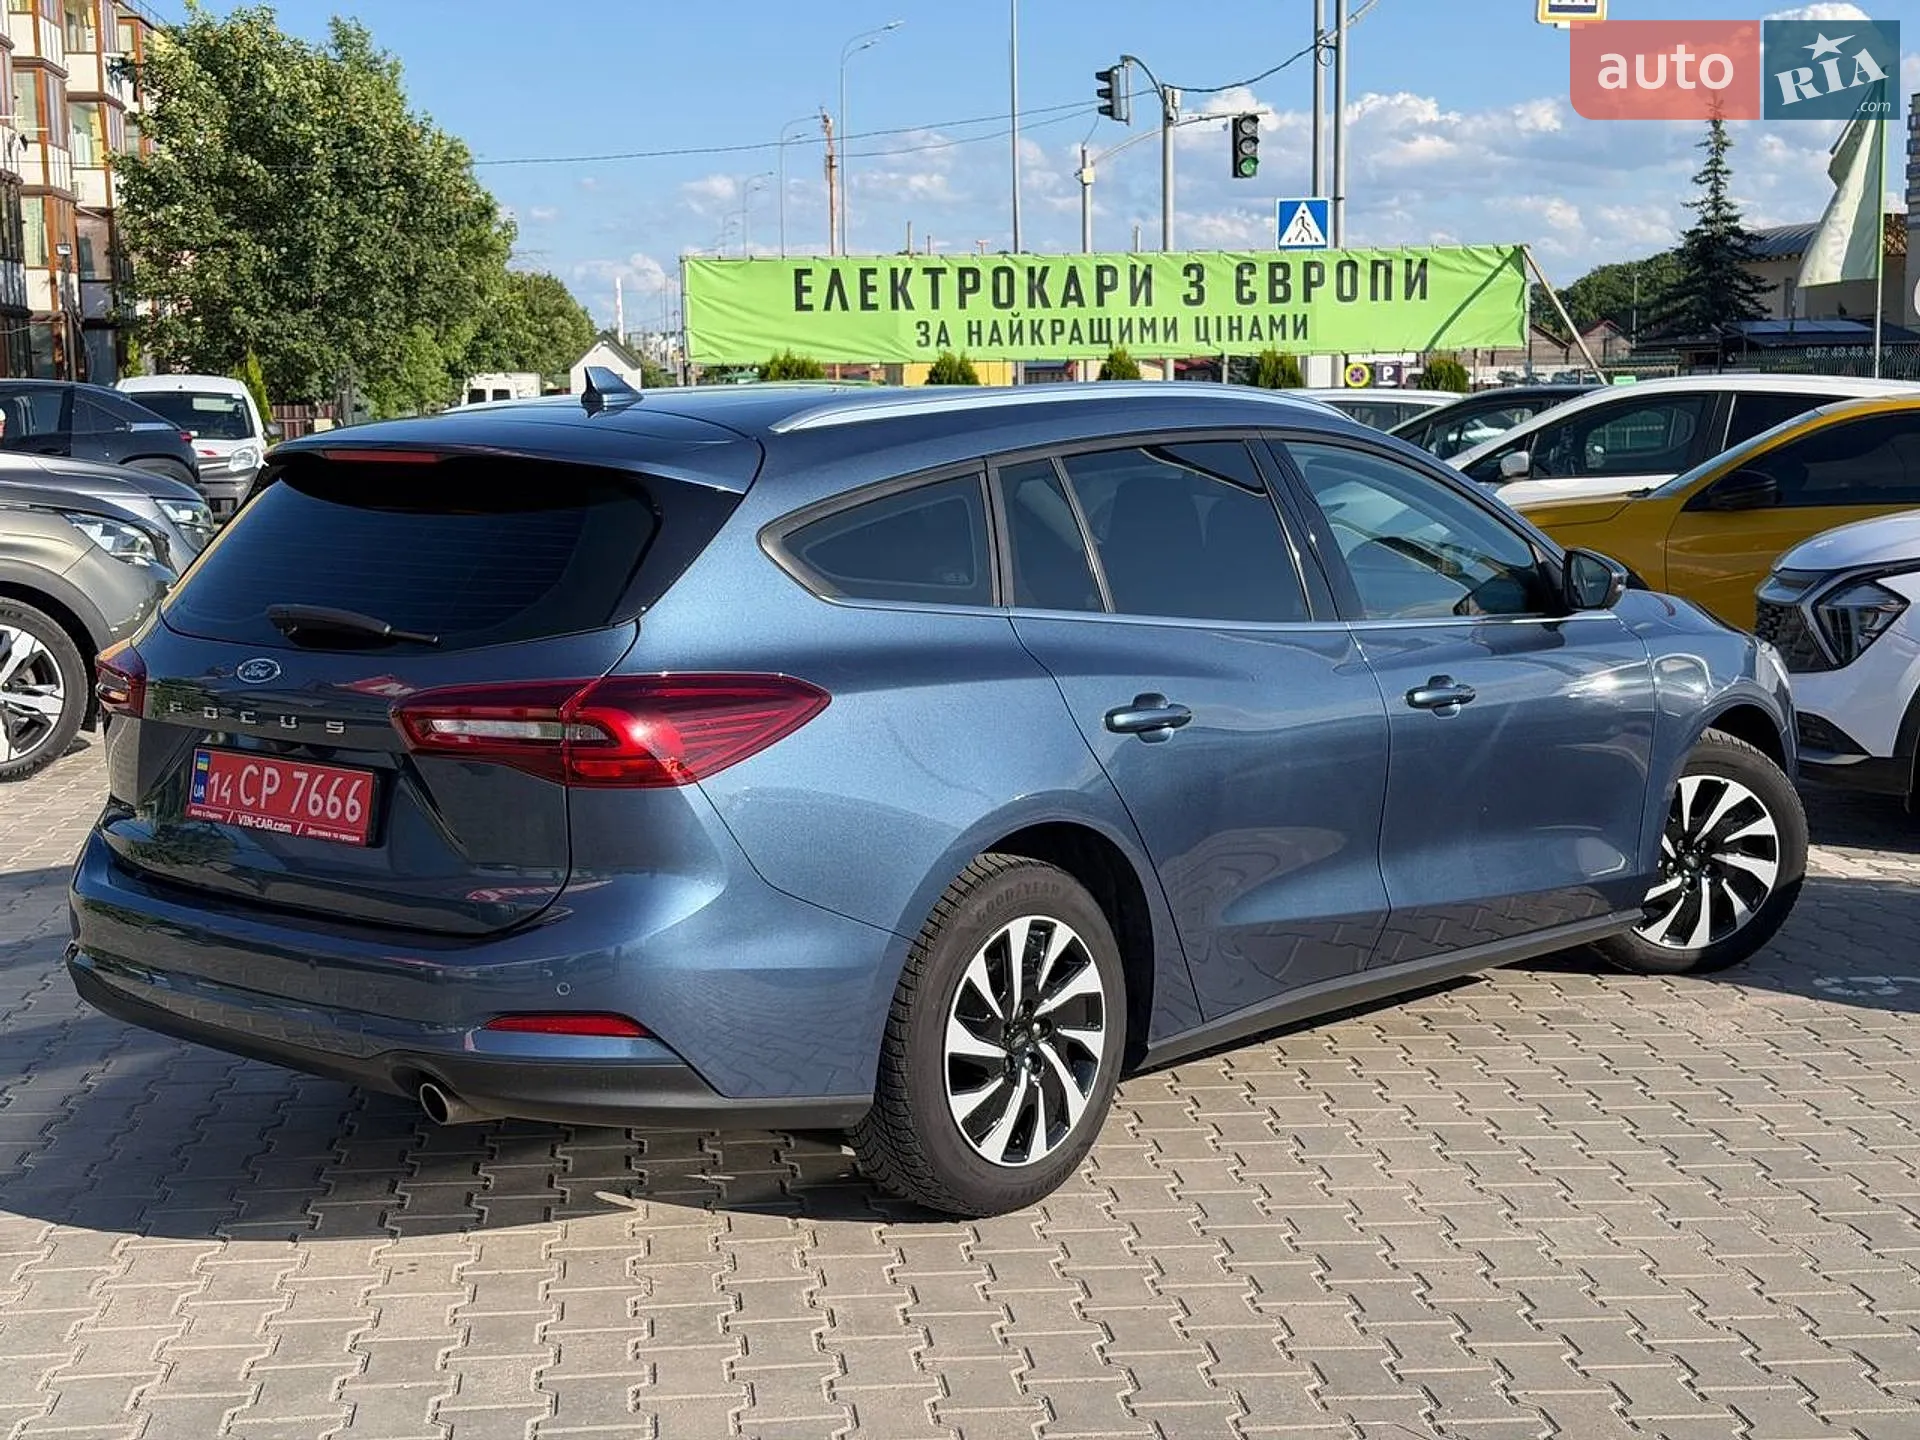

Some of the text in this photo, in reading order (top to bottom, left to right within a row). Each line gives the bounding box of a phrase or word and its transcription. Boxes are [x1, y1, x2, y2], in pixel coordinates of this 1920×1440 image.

[793, 258, 1429, 312] ЕЛЕКТРОКАРИ З ЄВРОПИ
[916, 311, 1308, 349] ЗА НАЙКРАЩИМИ ЦІНАМИ
[1383, 366, 1394, 381] P
[169, 701, 345, 734] FOCUS
[193, 784, 206, 798] UA
[209, 764, 363, 823] 14 CP 7666
